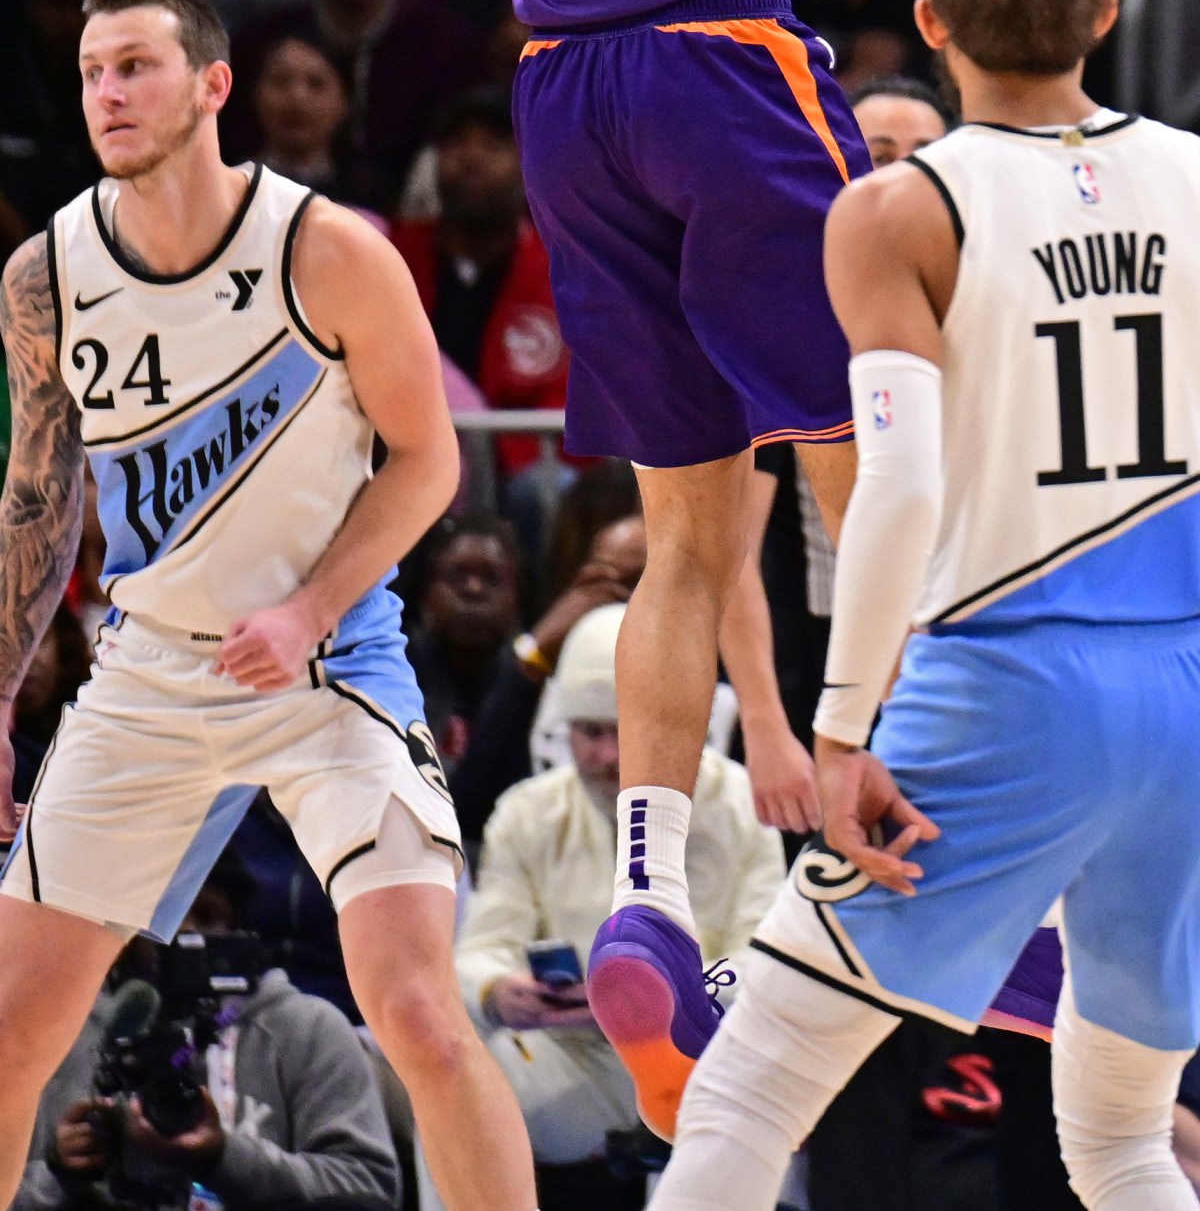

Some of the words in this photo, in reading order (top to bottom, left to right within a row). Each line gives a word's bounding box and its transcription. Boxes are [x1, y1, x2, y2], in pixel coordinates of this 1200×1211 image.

[215, 290, 231, 300] the
[228, 268, 263, 311] Y
[1031, 231, 1166, 305] YOUNG
[72, 333, 171, 409] 24
[1034, 313, 1188, 486] 11
[112, 382, 280, 566] Hawks
